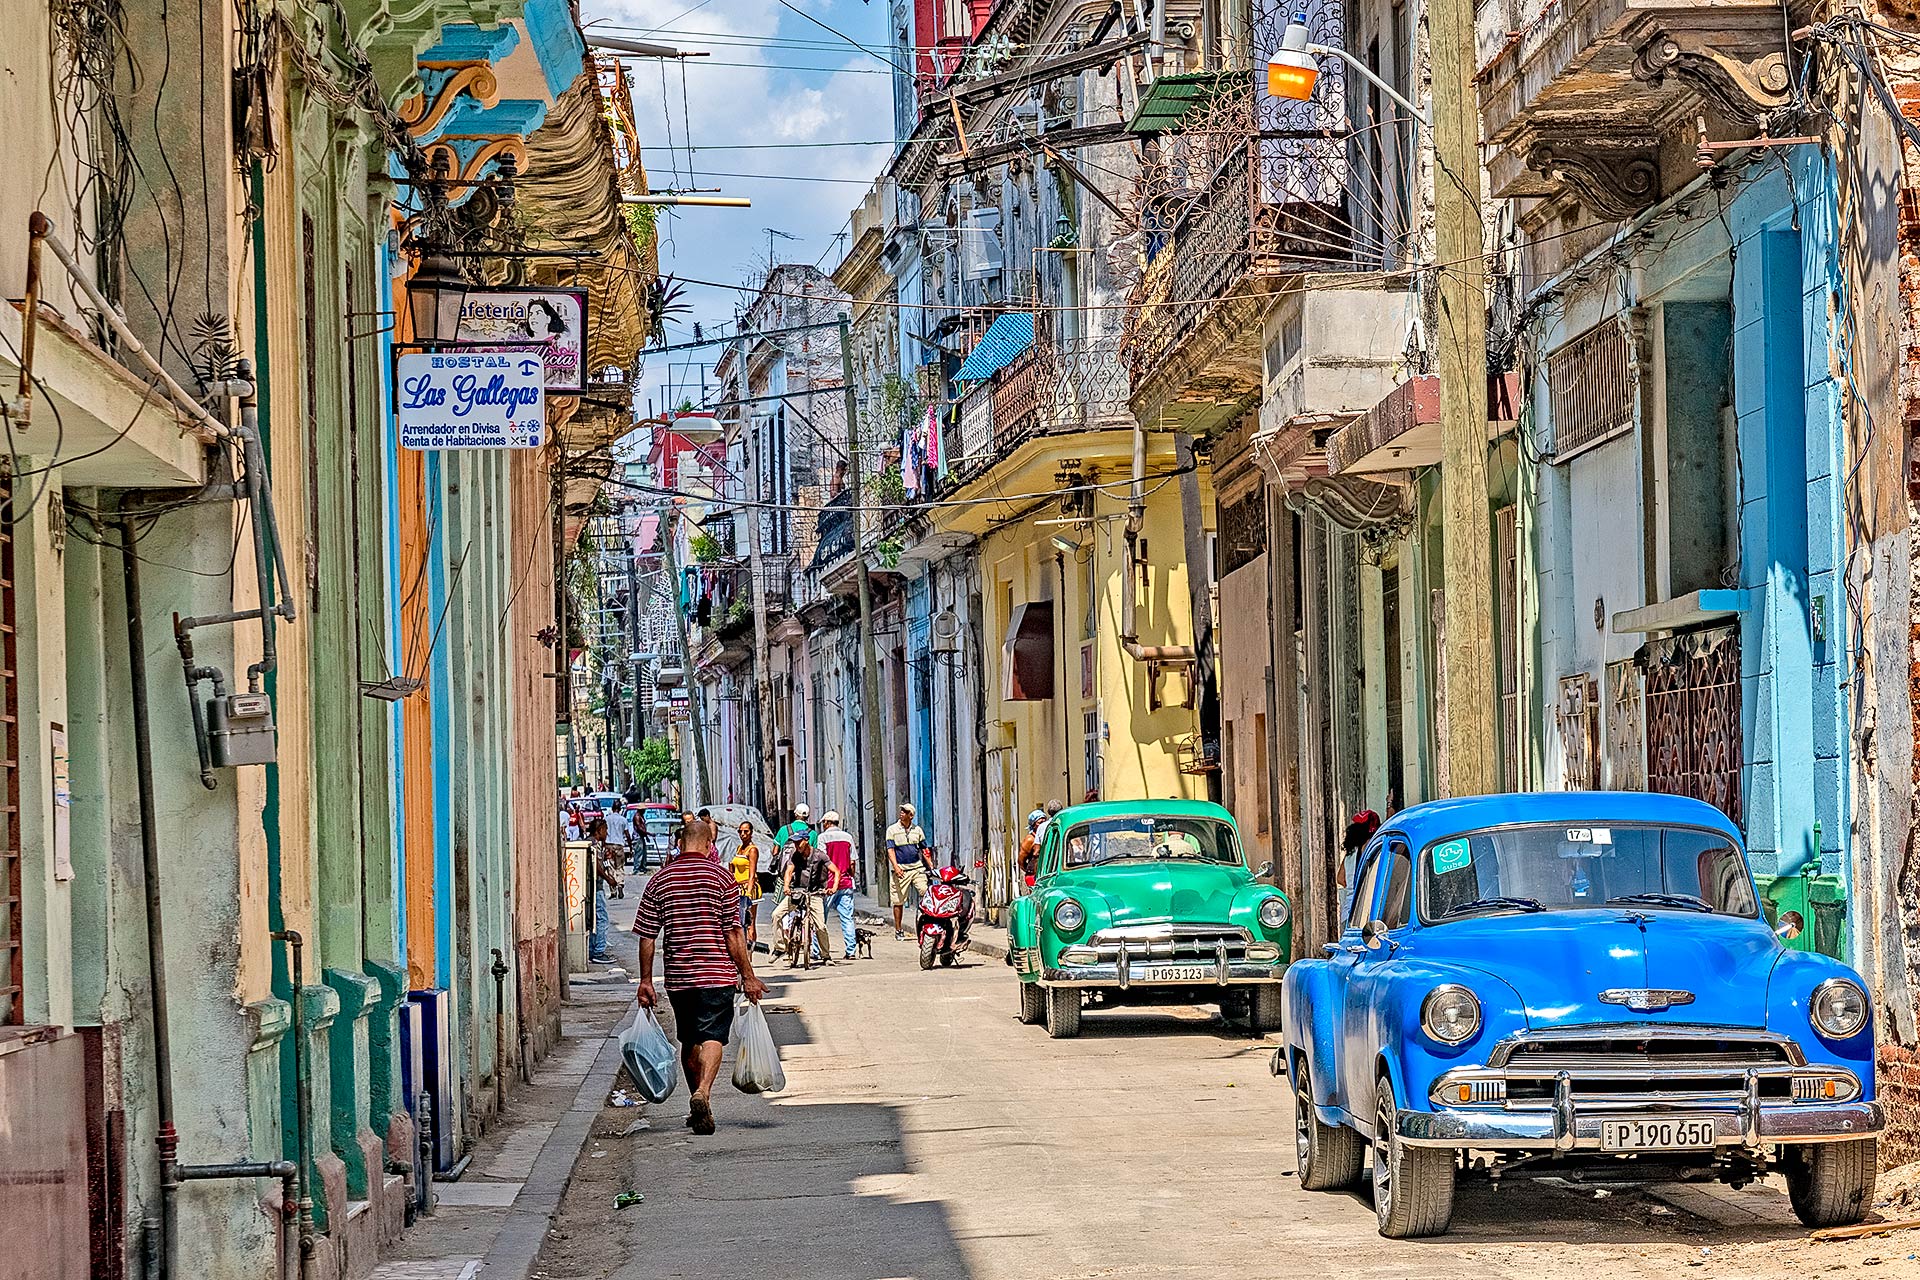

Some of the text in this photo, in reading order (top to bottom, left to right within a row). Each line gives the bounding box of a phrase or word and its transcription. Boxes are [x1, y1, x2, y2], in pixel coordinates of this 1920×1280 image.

[431, 356, 511, 369] HOSTAL
[402, 373, 539, 419] Las Gallegas
[402, 423, 500, 435] Arrendador en Divisa
[402, 435, 507, 447] Renta de Habitaciones
[1568, 830, 1581, 840] 17
[1634, 1124, 1672, 1147] 190
[1675, 1122, 1713, 1146] 650
